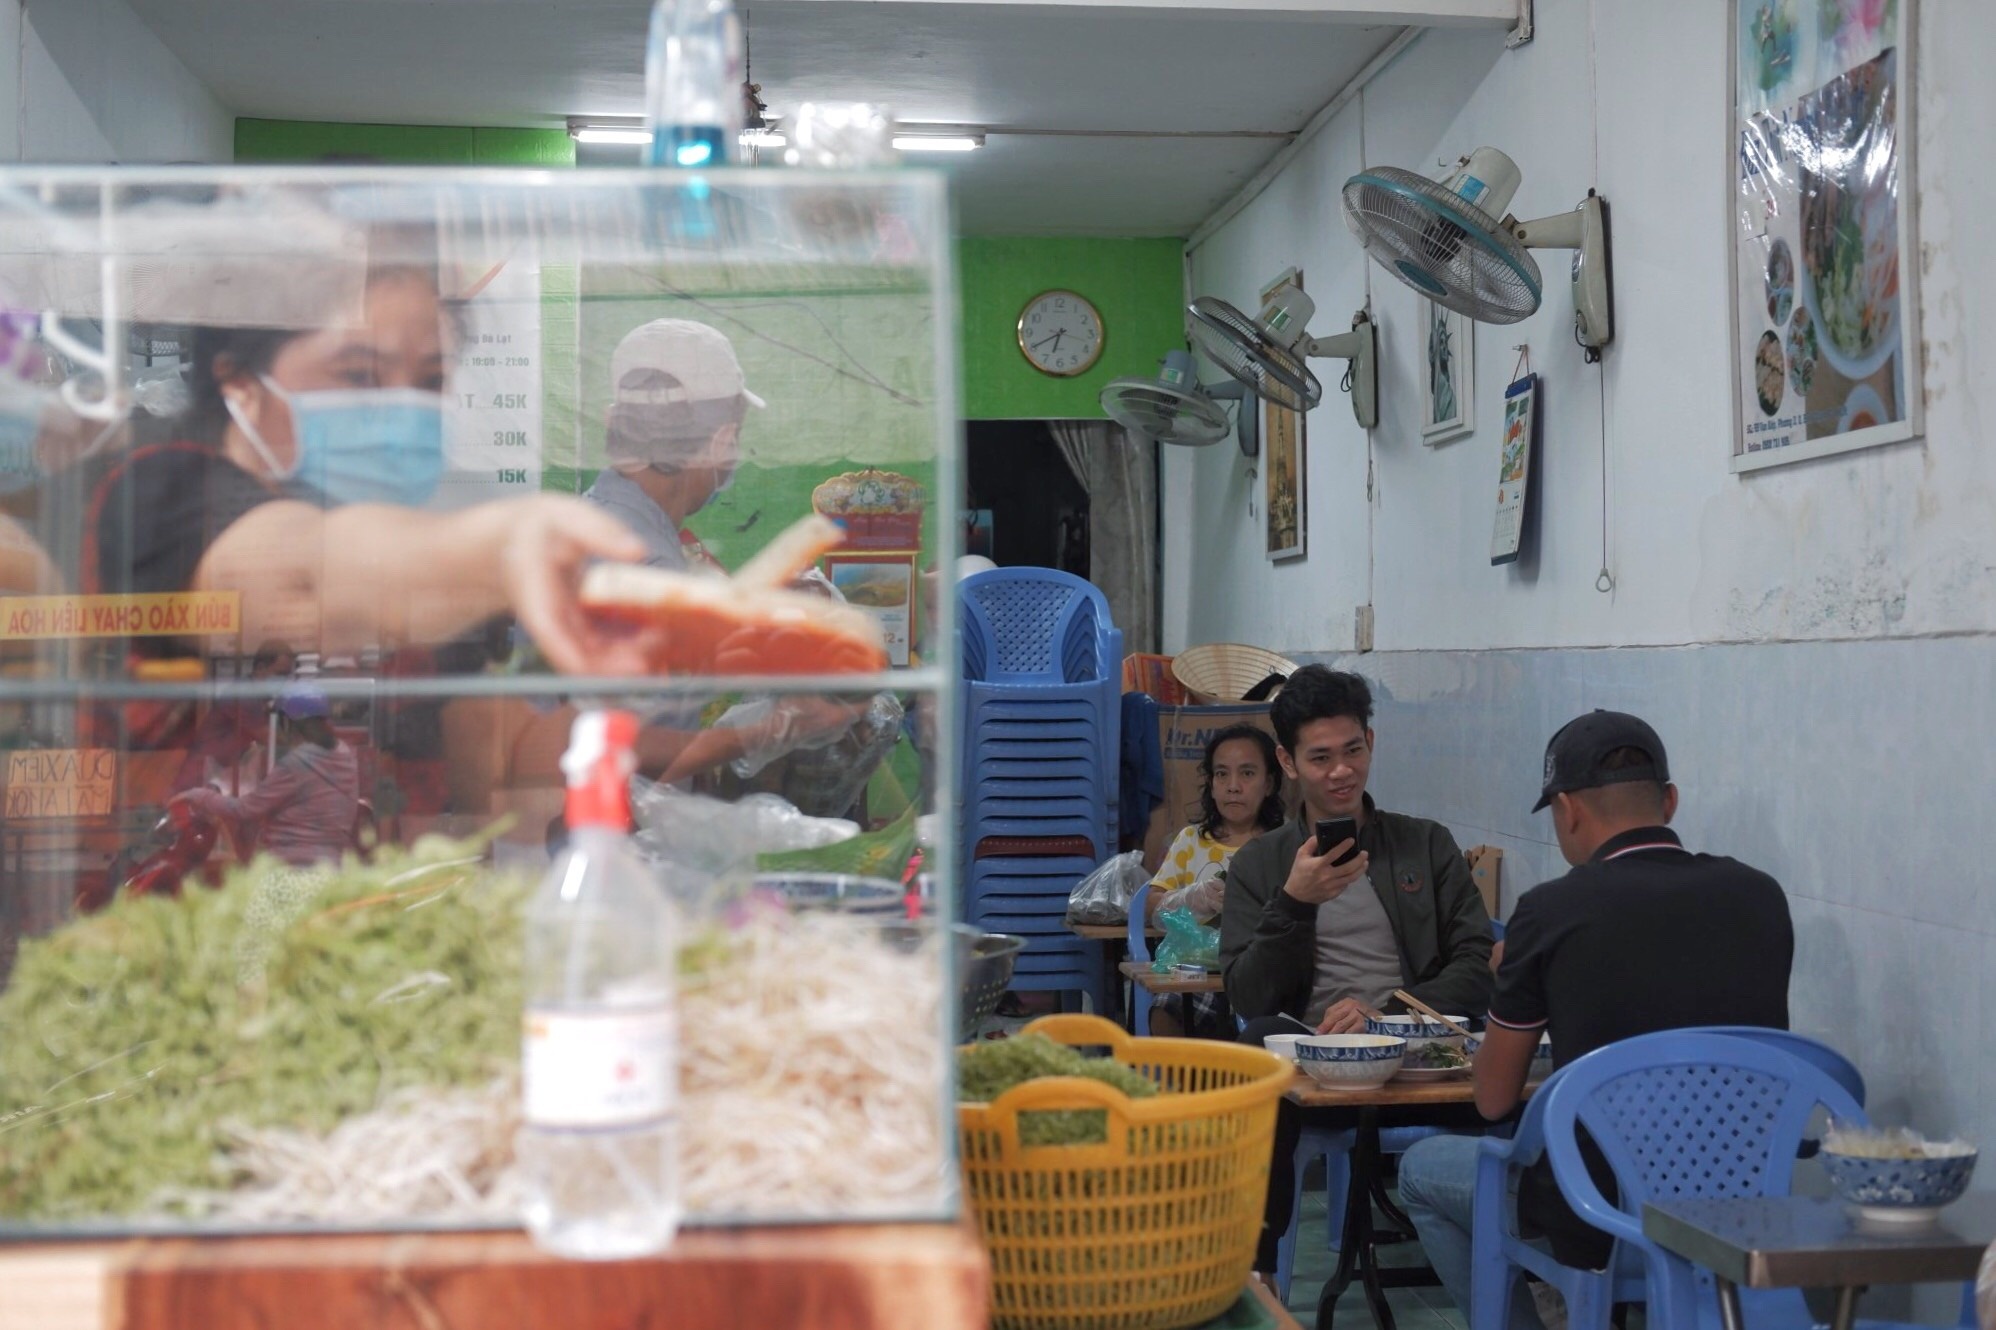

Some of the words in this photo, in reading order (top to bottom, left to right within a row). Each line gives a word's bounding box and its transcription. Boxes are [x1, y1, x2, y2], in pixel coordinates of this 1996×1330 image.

[1055, 298, 1065, 308] 12
[1031, 313, 1041, 324] 10
[1080, 315, 1088, 325] 2
[1026, 328, 1033, 337] 9
[1088, 329, 1095, 339] 3
[1083, 344, 1089, 353] 4
[1042, 354, 1050, 363] 7
[1056, 358, 1063, 368] 6
[1070, 355, 1078, 364] 5
[493, 393, 527, 409] 45K
[493, 431, 527, 447] 30K
[496, 469, 527, 484] 15K
